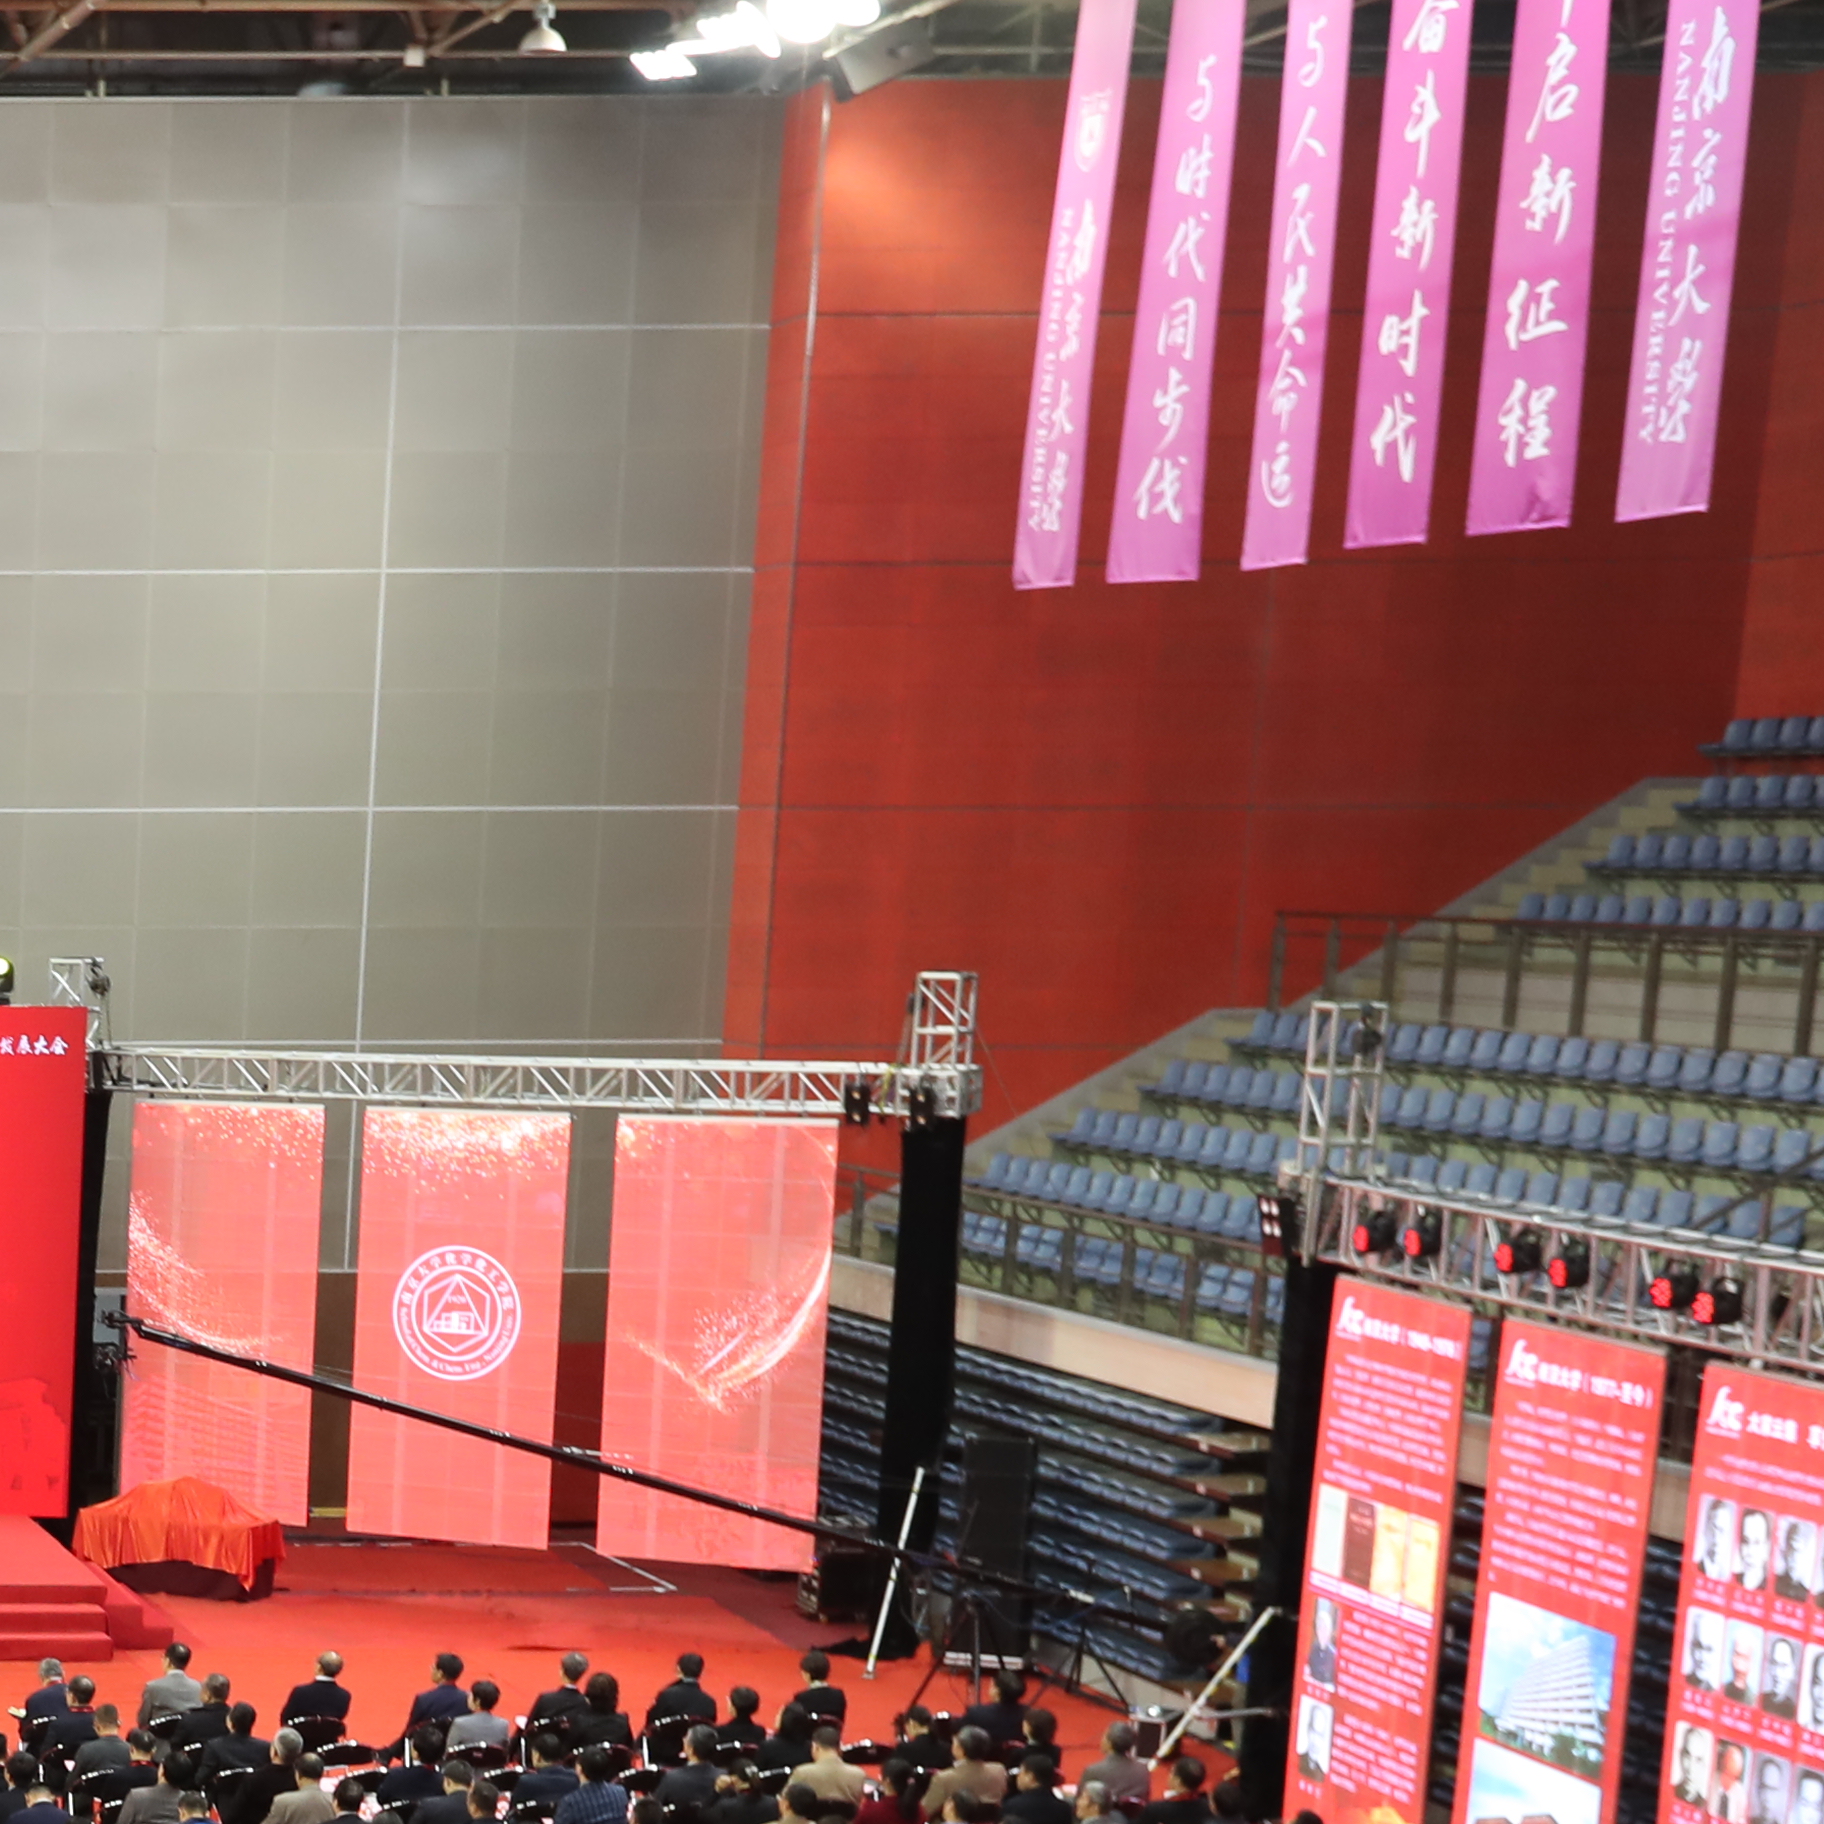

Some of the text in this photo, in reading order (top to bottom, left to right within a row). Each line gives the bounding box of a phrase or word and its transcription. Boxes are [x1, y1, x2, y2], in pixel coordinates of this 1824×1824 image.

[1132, 53, 1218, 524] 与时代同步伐
[1261, 14, 1328, 508] 与人民共命运
[1498, 0, 1581, 468] 启新征程
